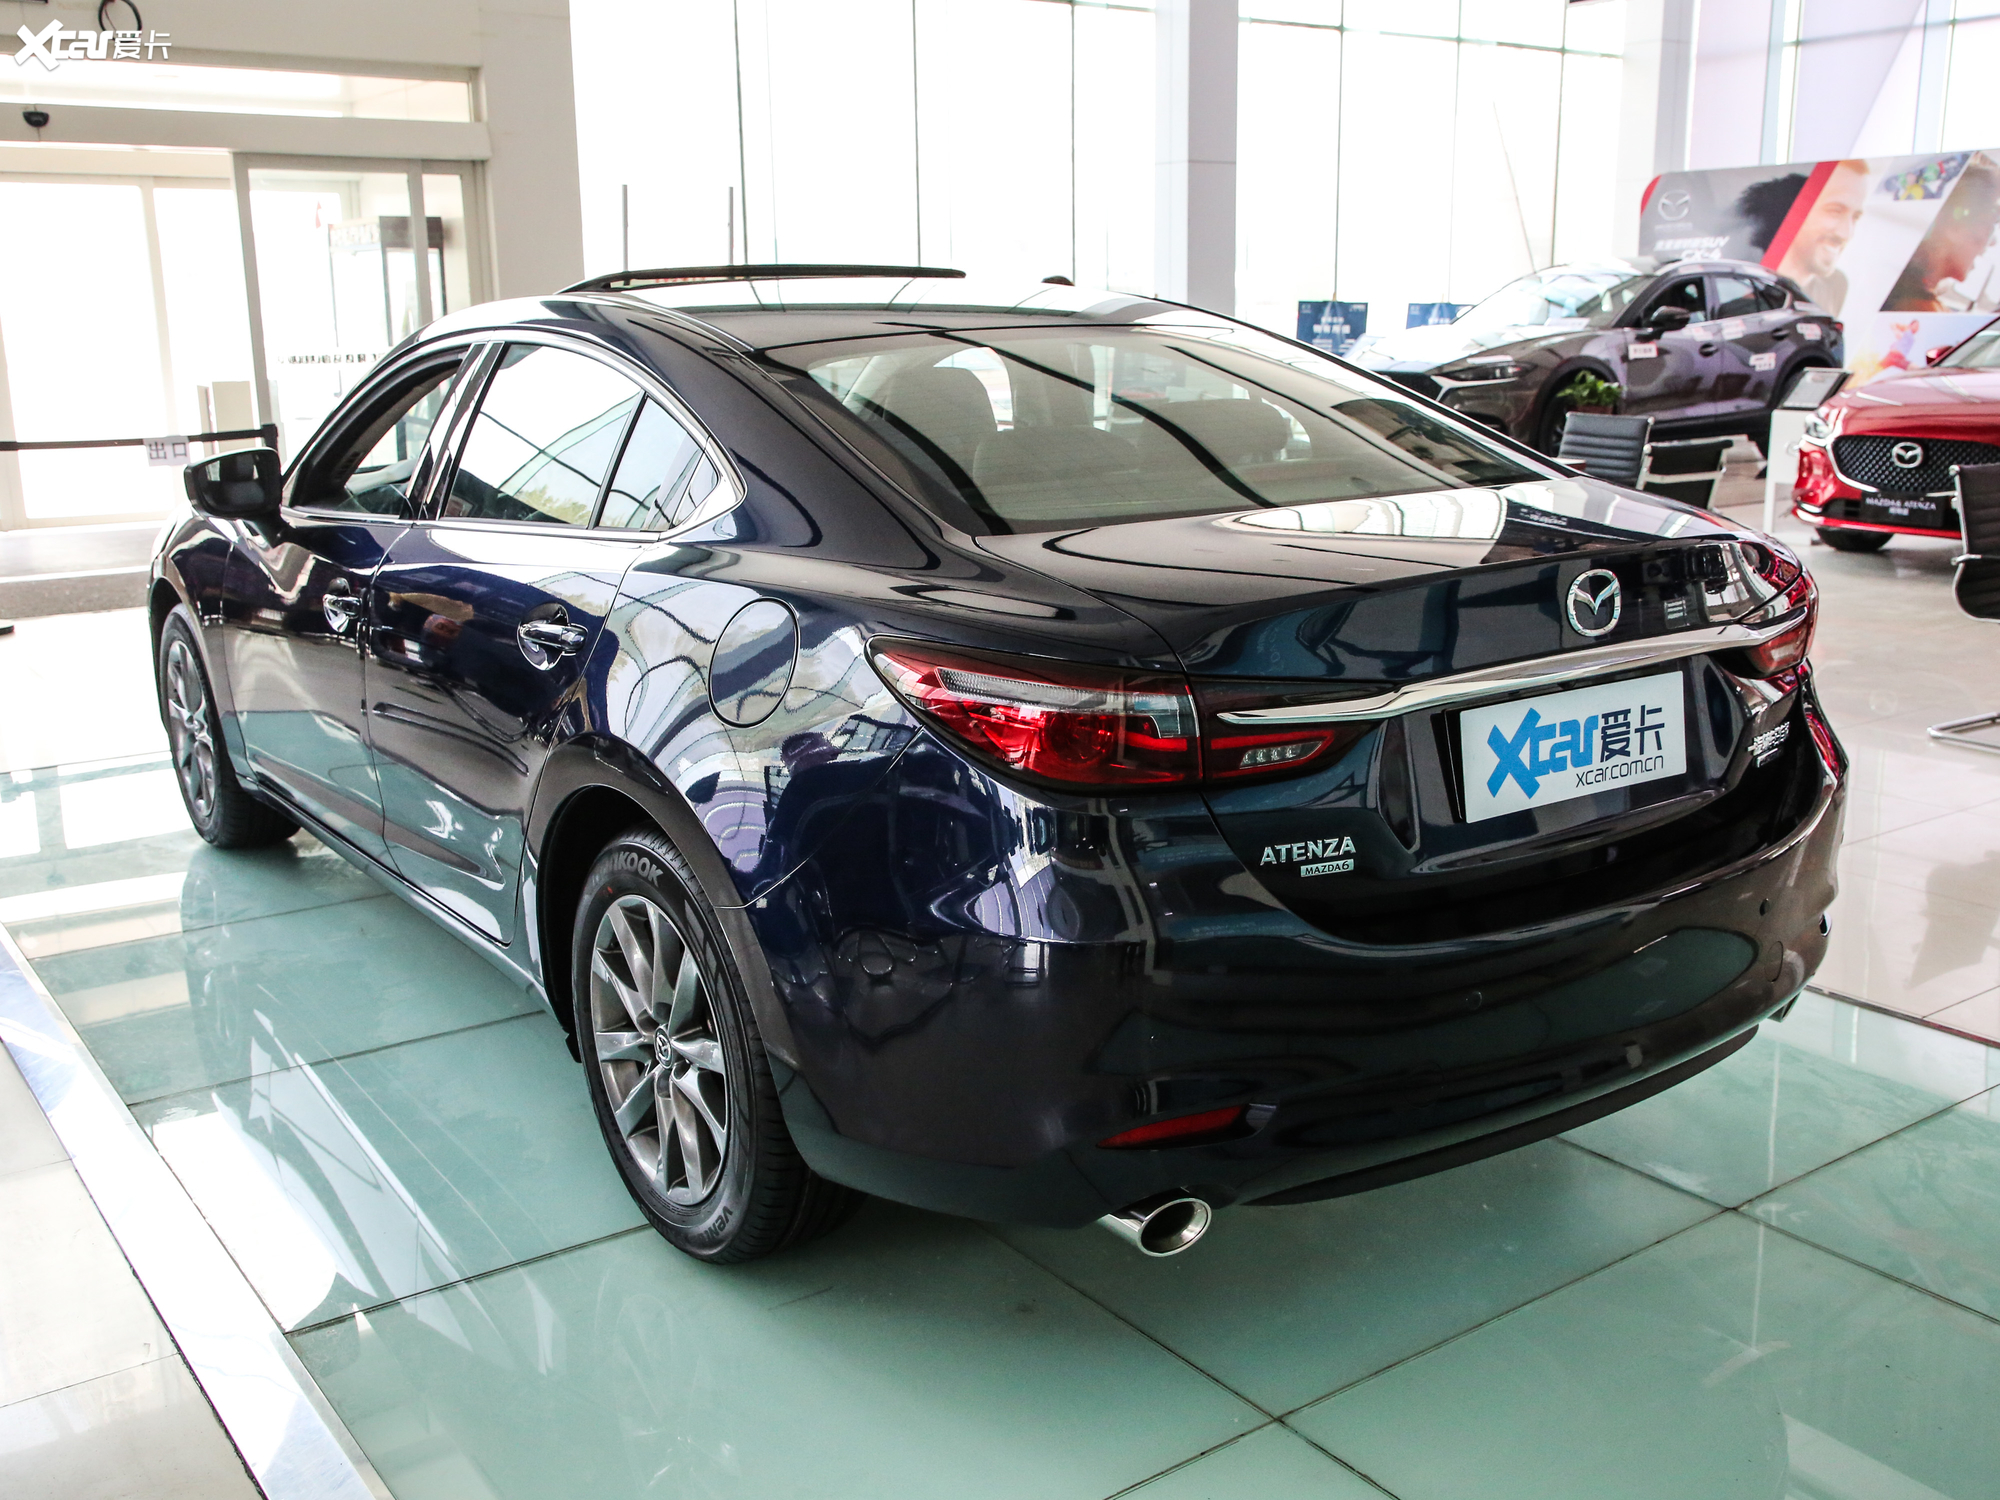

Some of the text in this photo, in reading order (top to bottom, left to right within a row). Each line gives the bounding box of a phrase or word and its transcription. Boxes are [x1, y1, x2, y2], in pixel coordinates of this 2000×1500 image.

[149, 441, 187, 459] 出口
[1600, 705, 1665, 762] 爱卡
[1575, 755, 1665, 788] xcar.com.cn
[1260, 836, 1357, 866] ATENZA
[1304, 860, 1350, 876] MAZDA6
